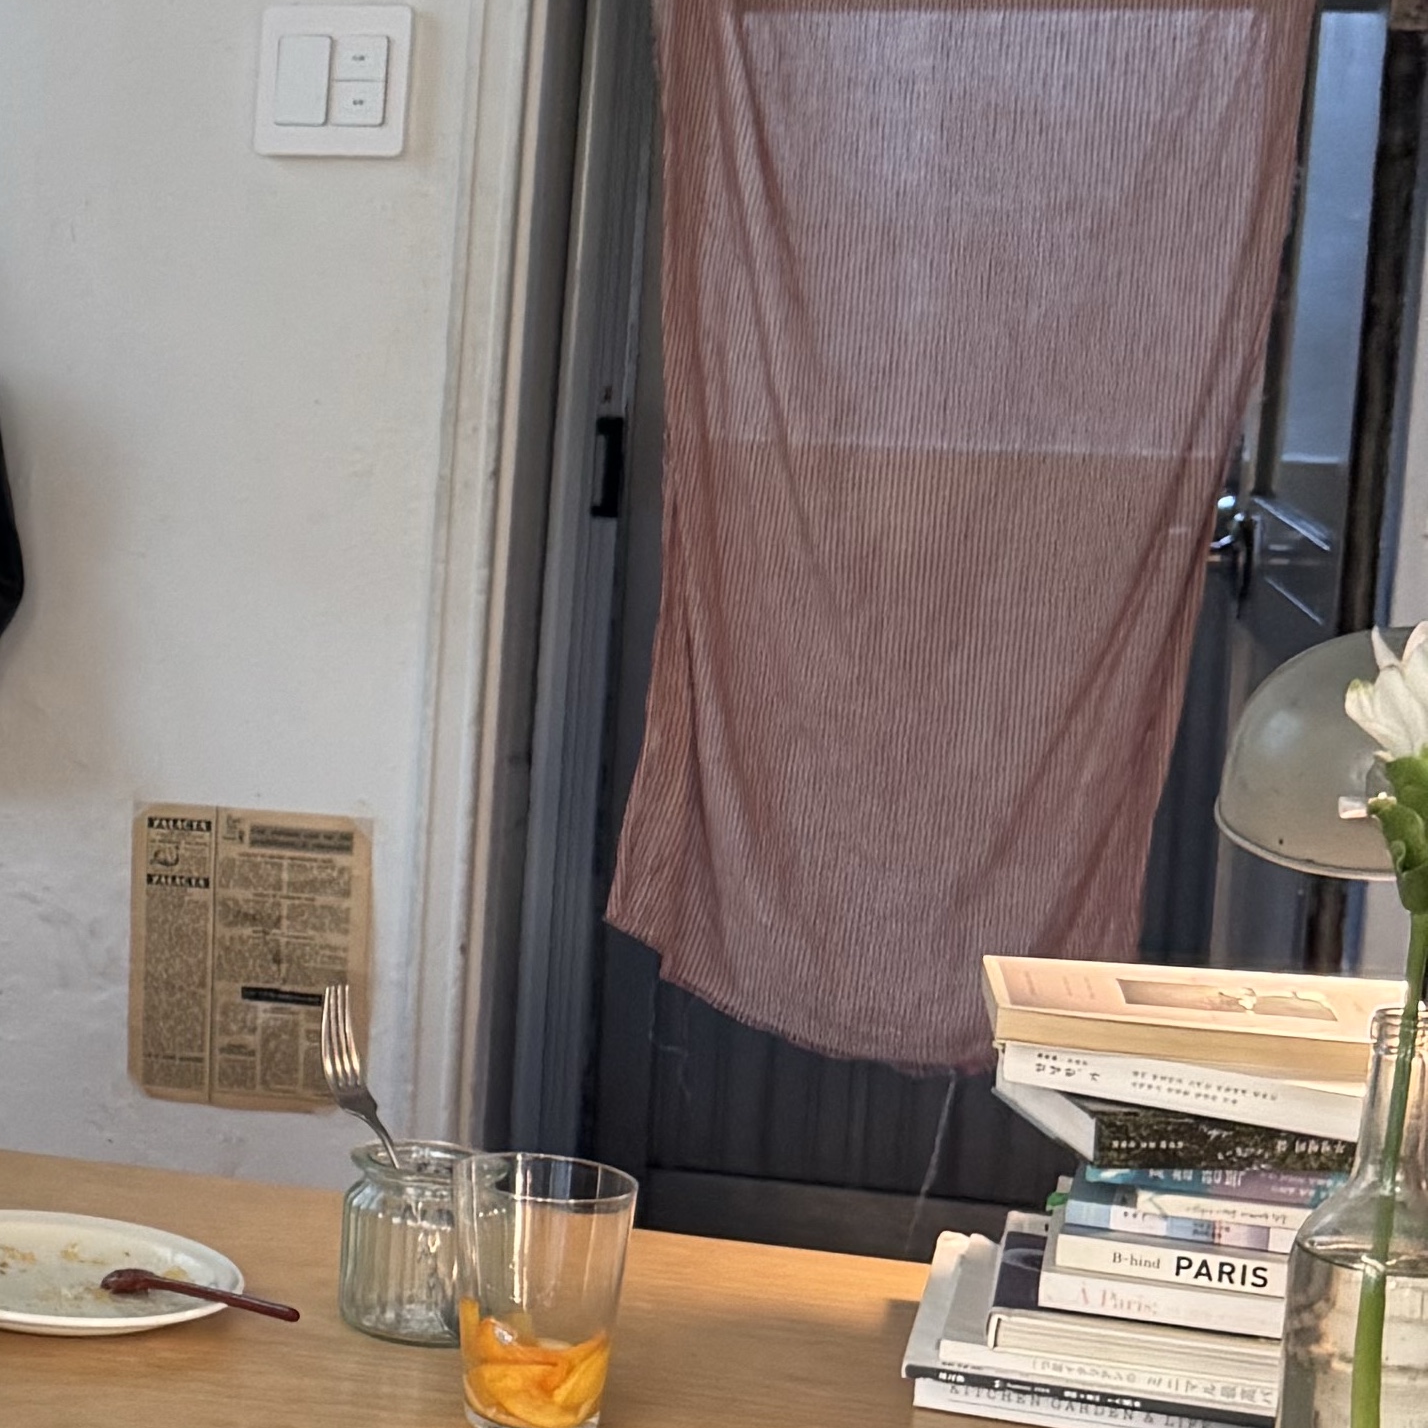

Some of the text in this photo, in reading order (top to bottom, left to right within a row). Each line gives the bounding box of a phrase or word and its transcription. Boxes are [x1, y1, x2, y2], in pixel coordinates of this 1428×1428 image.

[1112, 1251, 1269, 1288] B-hind PARIS
[949, 1384, 1042, 1407] KITCHEN
[1051, 1397, 1134, 1421] GARDEN
